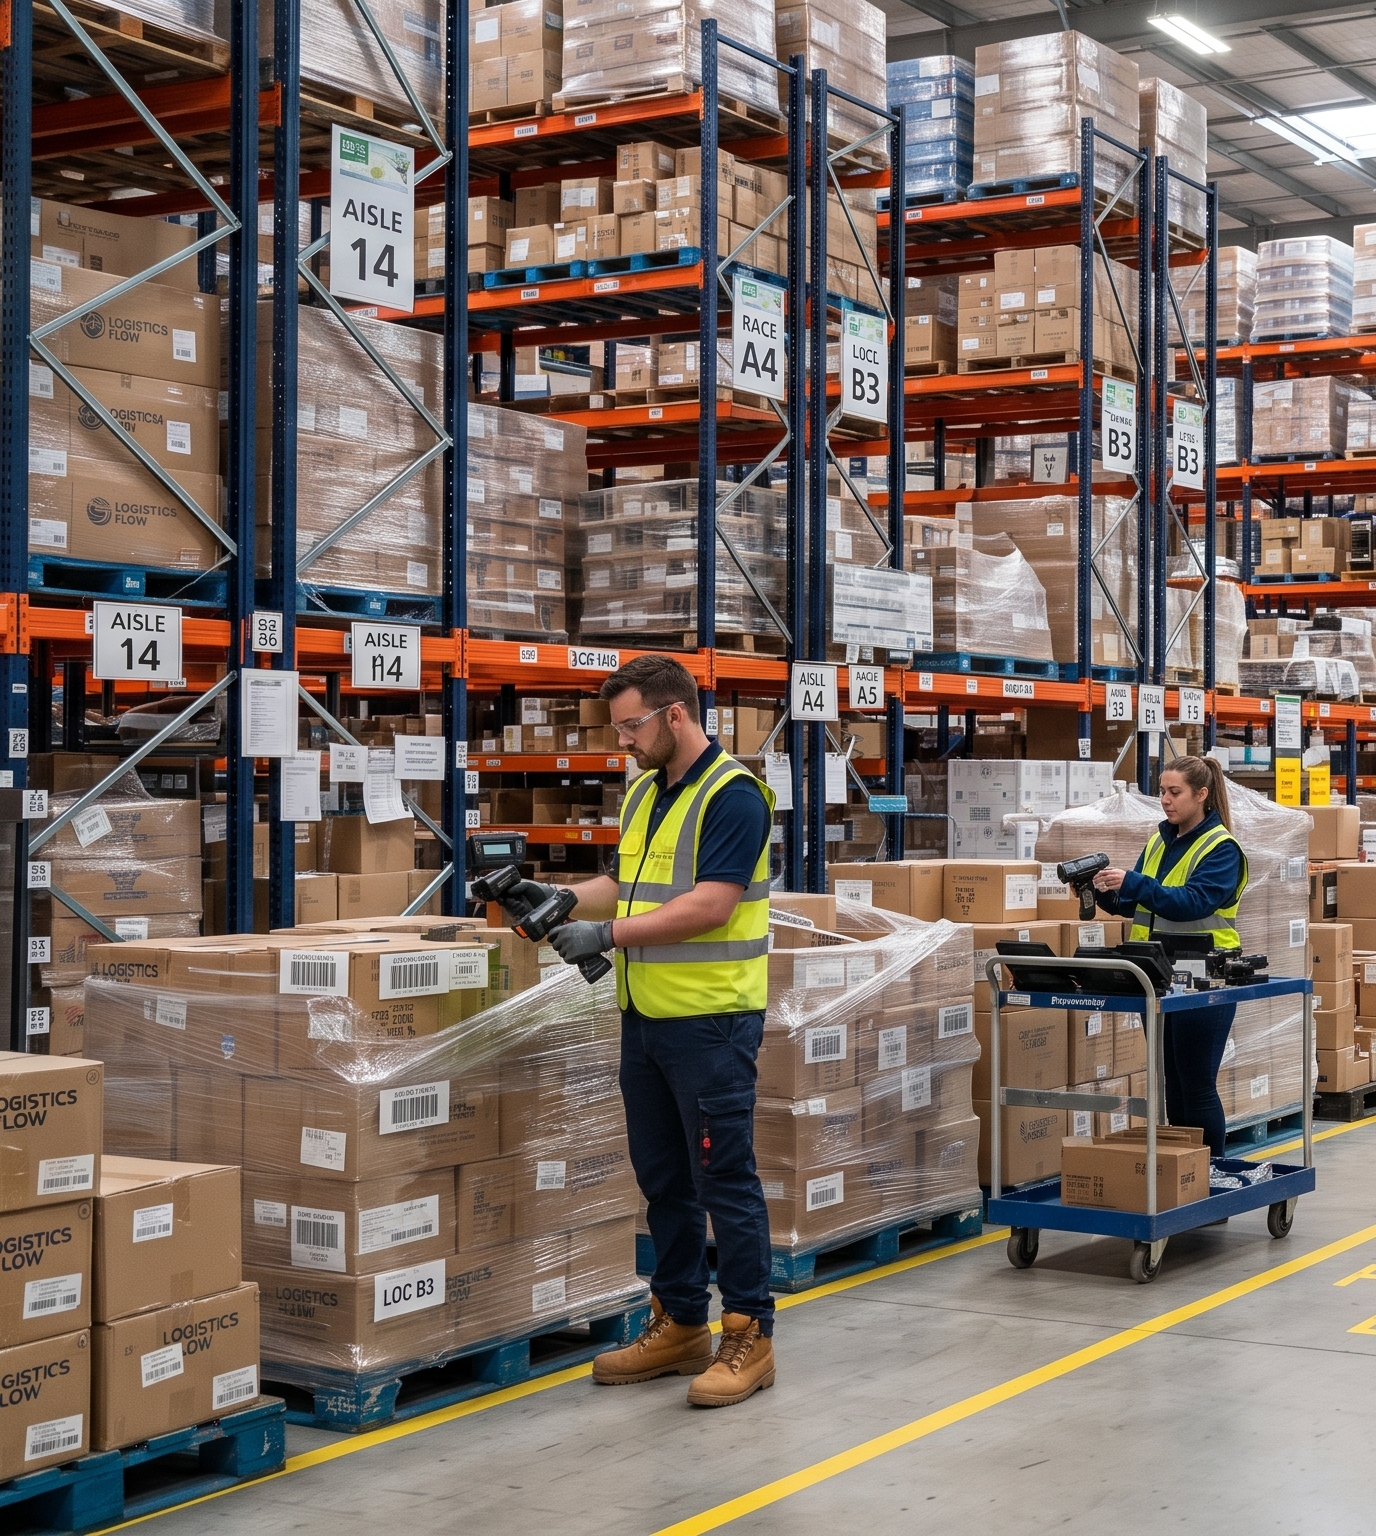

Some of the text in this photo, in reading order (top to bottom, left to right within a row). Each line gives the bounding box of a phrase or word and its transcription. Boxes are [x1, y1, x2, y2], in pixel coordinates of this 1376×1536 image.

[342, 198, 402, 234] AISLE
[350, 237, 399, 288] 14
[108, 316, 168, 336] LOGISTICS
[108, 328, 140, 342] FLOW
[741, 314, 777, 340] RACE
[740, 340, 778, 382] A4
[852, 367, 880, 405] B3
[1108, 427, 1132, 461] B3
[1178, 444, 1198, 475] B3
[115, 502, 177, 517] LOGISTICS
[115, 514, 147, 526] FLOW
[110, 612, 165, 633] AISLE
[364, 632, 407, 650] AISLE
[120, 637, 161, 672] 14
[802, 690, 825, 712] A4
[857, 685, 877, 705] A5
[102, 962, 159, 978] LOGISTICS
[0, 1109, 47, 1130] LOW
[0, 1227, 72, 1254] GISTICS
[275, 1286, 338, 1307] LOGISTICS
[383, 1277, 434, 1307] LOC B3
[163, 1311, 239, 1346] LOGISTICS
